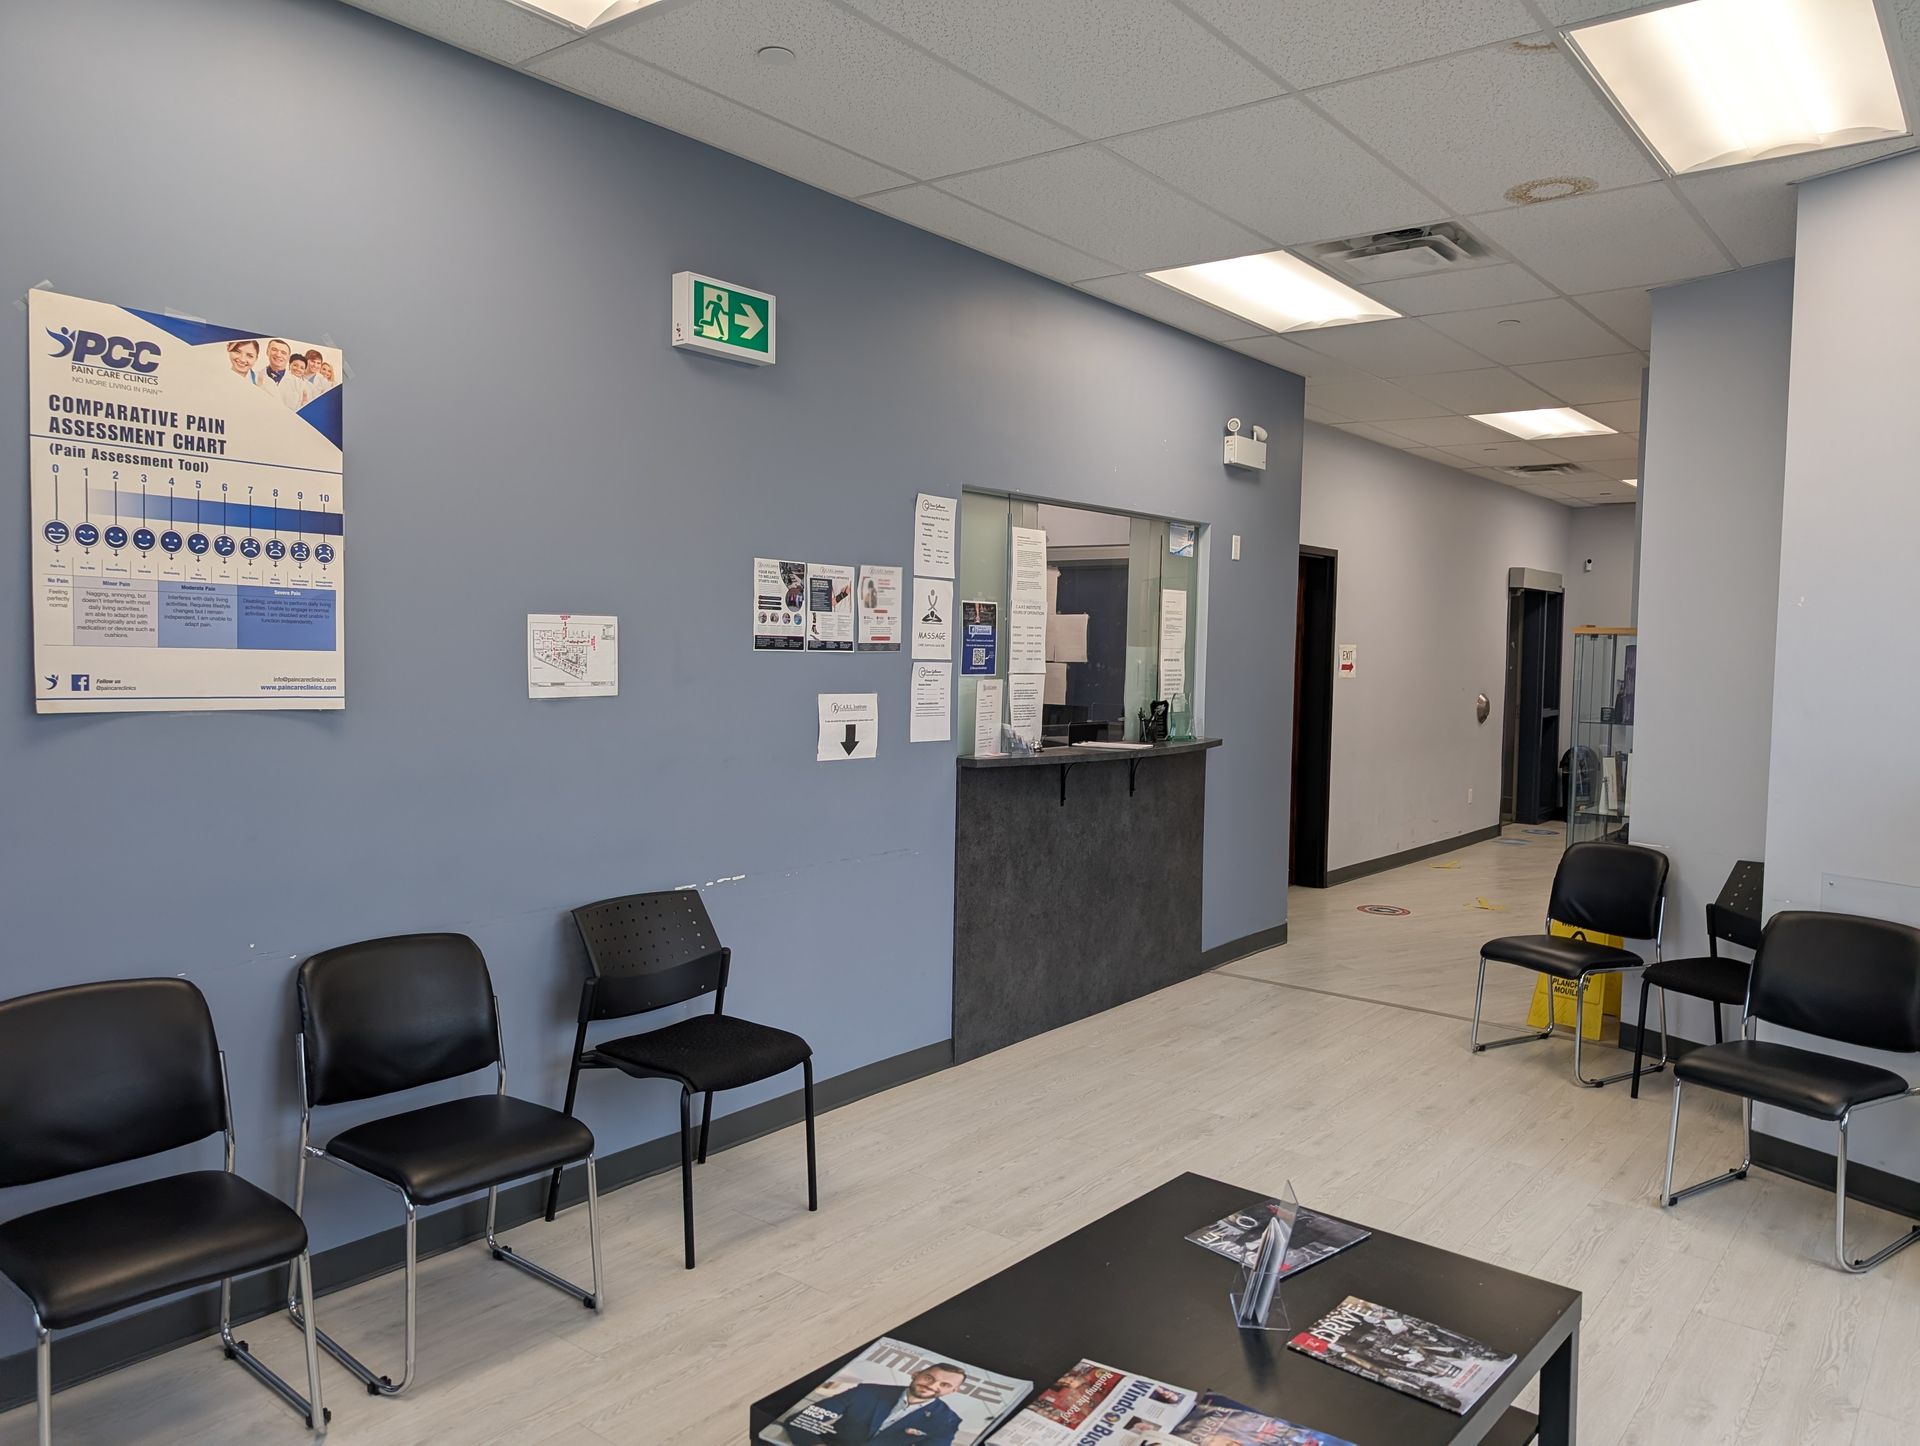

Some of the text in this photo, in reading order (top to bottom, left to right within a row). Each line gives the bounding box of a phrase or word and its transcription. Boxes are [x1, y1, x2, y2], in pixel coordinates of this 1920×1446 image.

[72, 331, 162, 374] PCC
[71, 365, 159, 386] PAIN CARE CLINICS
[72, 376, 83, 385] NO
[84, 378, 107, 388] MORE
[108, 381, 132, 391] LIVING
[133, 385, 141, 393] IN
[49, 394, 226, 435] COMPARATIVE PAIN
[49, 416, 227, 456] ASSESSMENT CHART
[50, 443, 209, 474] (Pain Assessment Tool)
[52, 464, 330, 503] 0 1 2 3 4 5 6 7 8 9 10
[918, 632, 946, 640] MASSAGE
[1343, 650, 1353, 661] EXIT
[1552, 977, 1589, 992] PLANCHR
[1311, 1303, 1373, 1343] DRIVE
[1060, 1371, 1114, 1424] Raising the Roof
[1191, 1406, 1228, 1444] CLUSIVE
